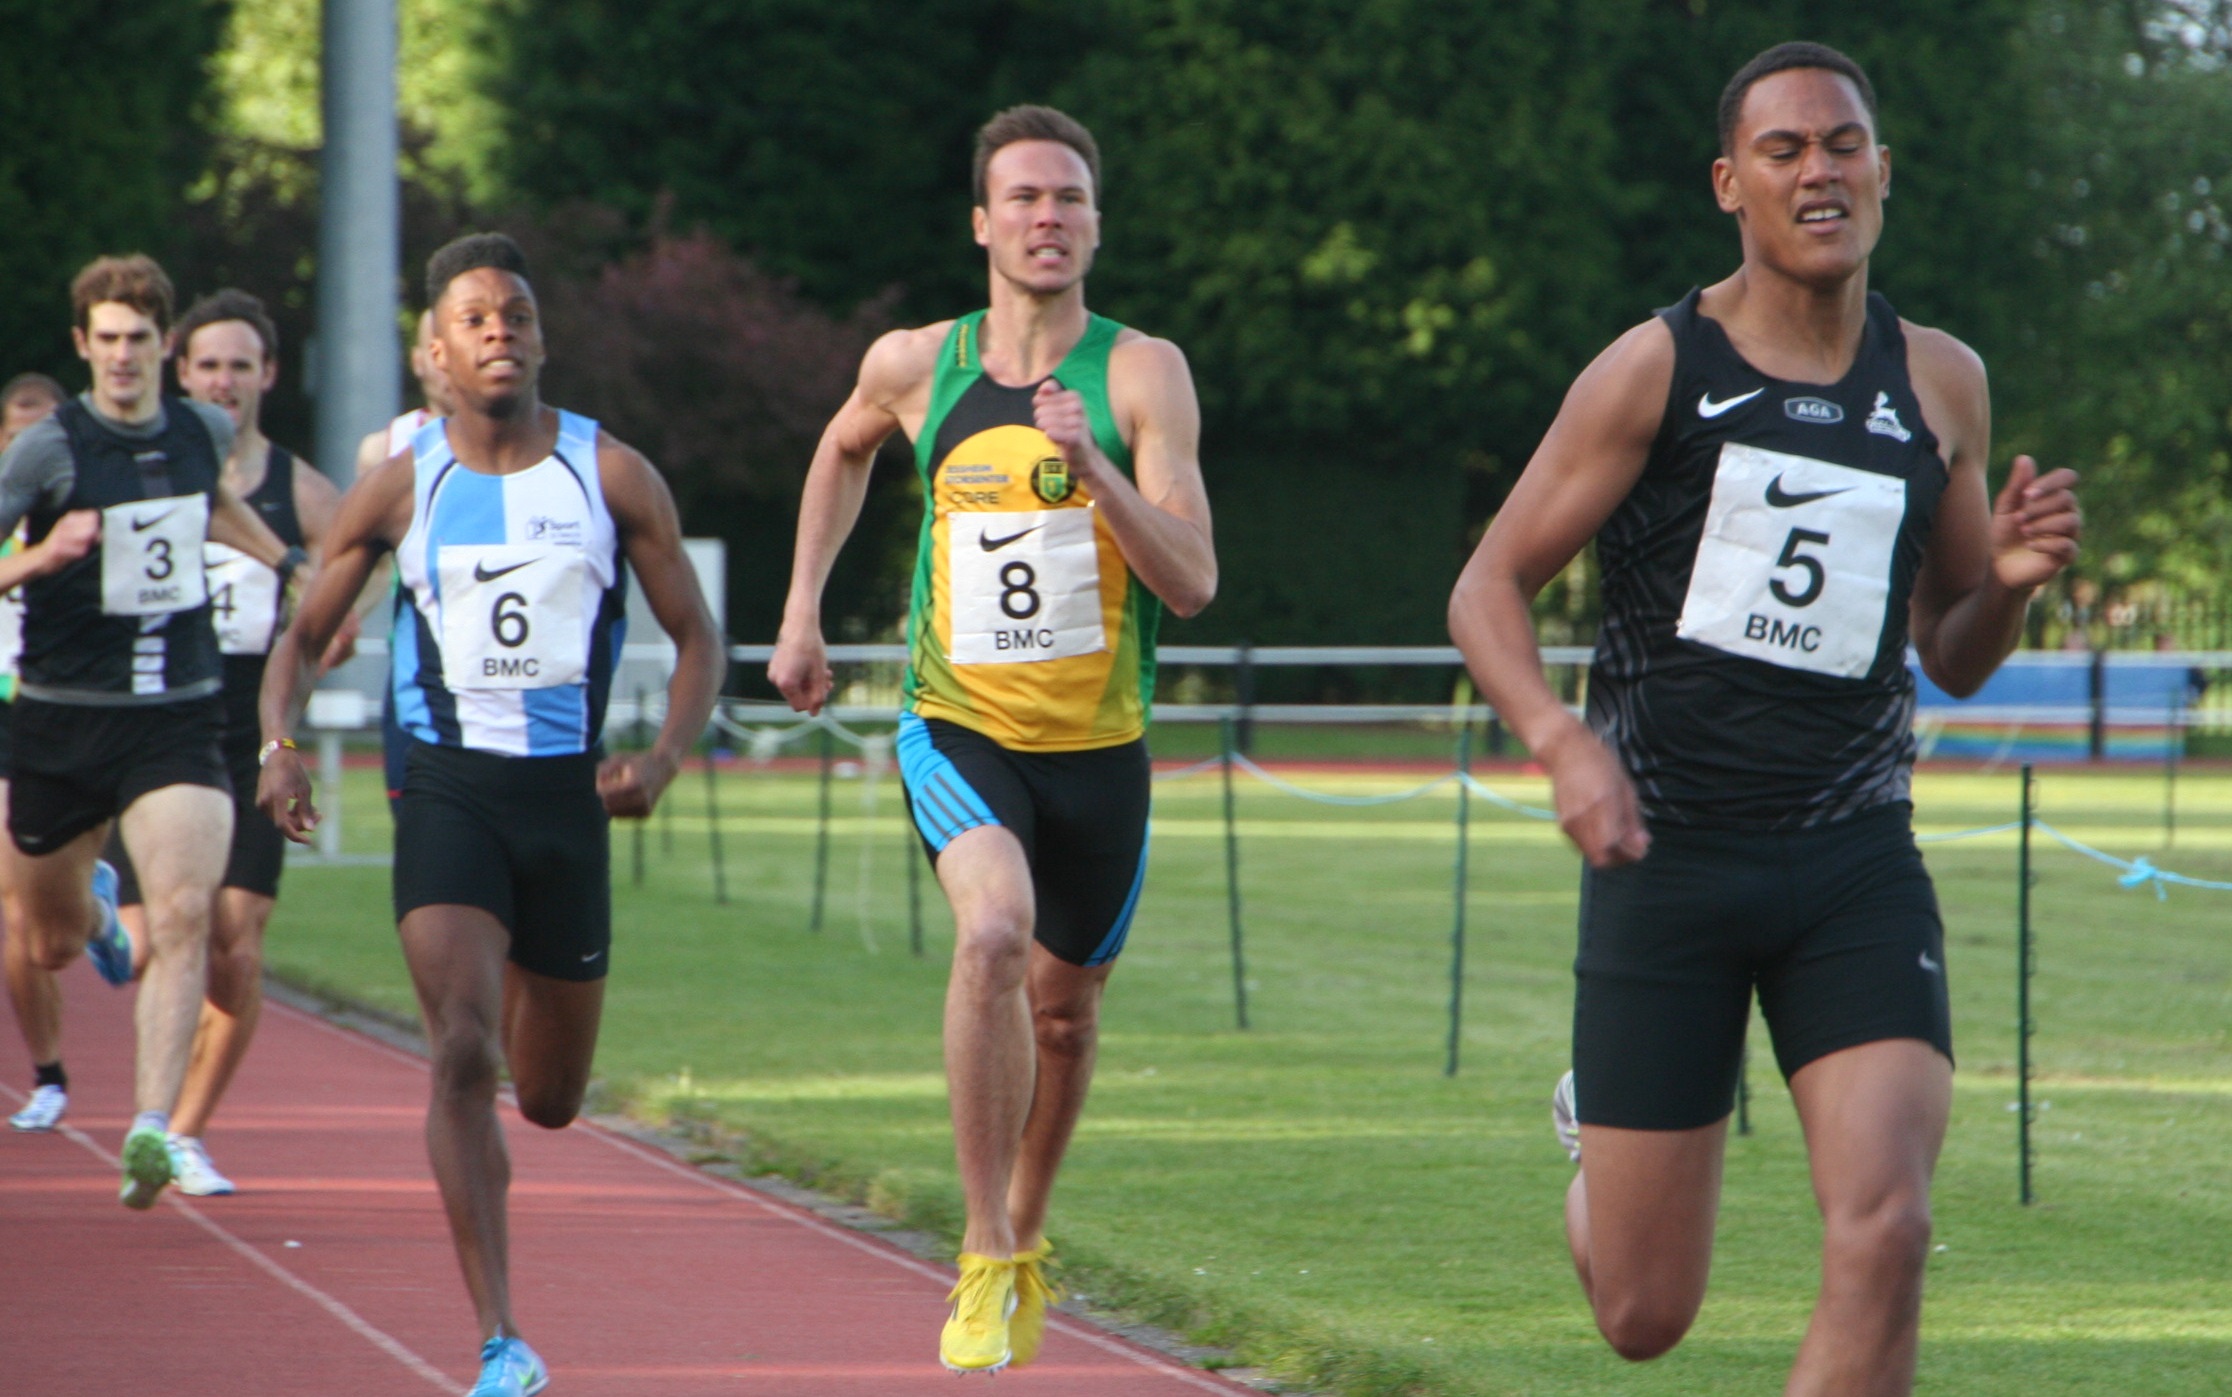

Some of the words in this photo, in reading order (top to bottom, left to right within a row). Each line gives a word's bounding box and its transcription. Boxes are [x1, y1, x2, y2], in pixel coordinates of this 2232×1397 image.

[1796, 402, 1831, 418] AGA
[145, 539, 173, 580] 3
[1769, 525, 1830, 608] 5
[139, 586, 181, 605] BMC
[212, 583, 236, 620] 4
[1000, 561, 1040, 620] 8
[492, 592, 529, 648] 6
[995, 628, 1054, 650] BMC
[1744, 613, 1822, 653] BMC
[483, 658, 539, 677] BMC
